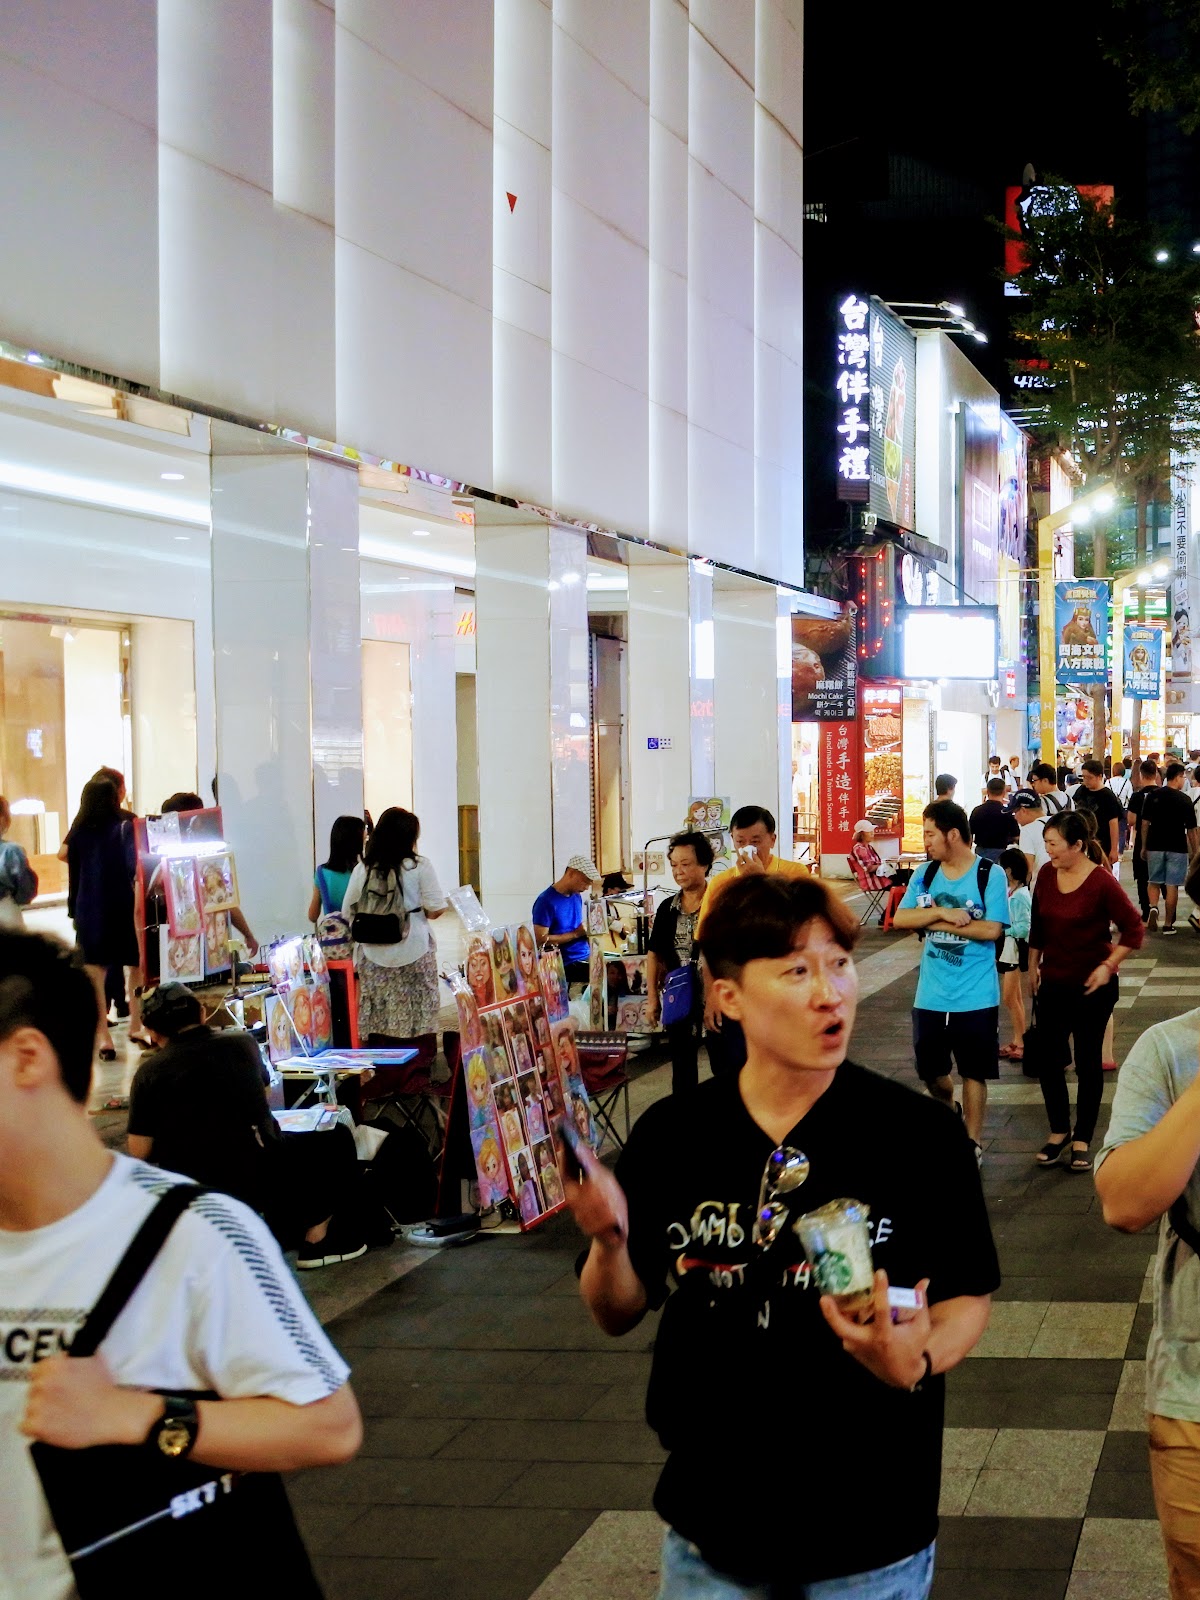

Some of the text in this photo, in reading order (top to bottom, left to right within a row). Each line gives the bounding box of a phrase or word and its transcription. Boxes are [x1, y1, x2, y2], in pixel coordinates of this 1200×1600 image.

[837, 294, 870, 481] 台灣伴手禮
[807, 692, 844, 700] Mochi Cake
[1042, 720, 1054, 730] 30
[826, 731, 834, 769] Handmade
[835, 724, 853, 833] 台灣手造伴手禮
[826, 802, 834, 832] Souvenir
[937, 948, 963, 967] LONDON
